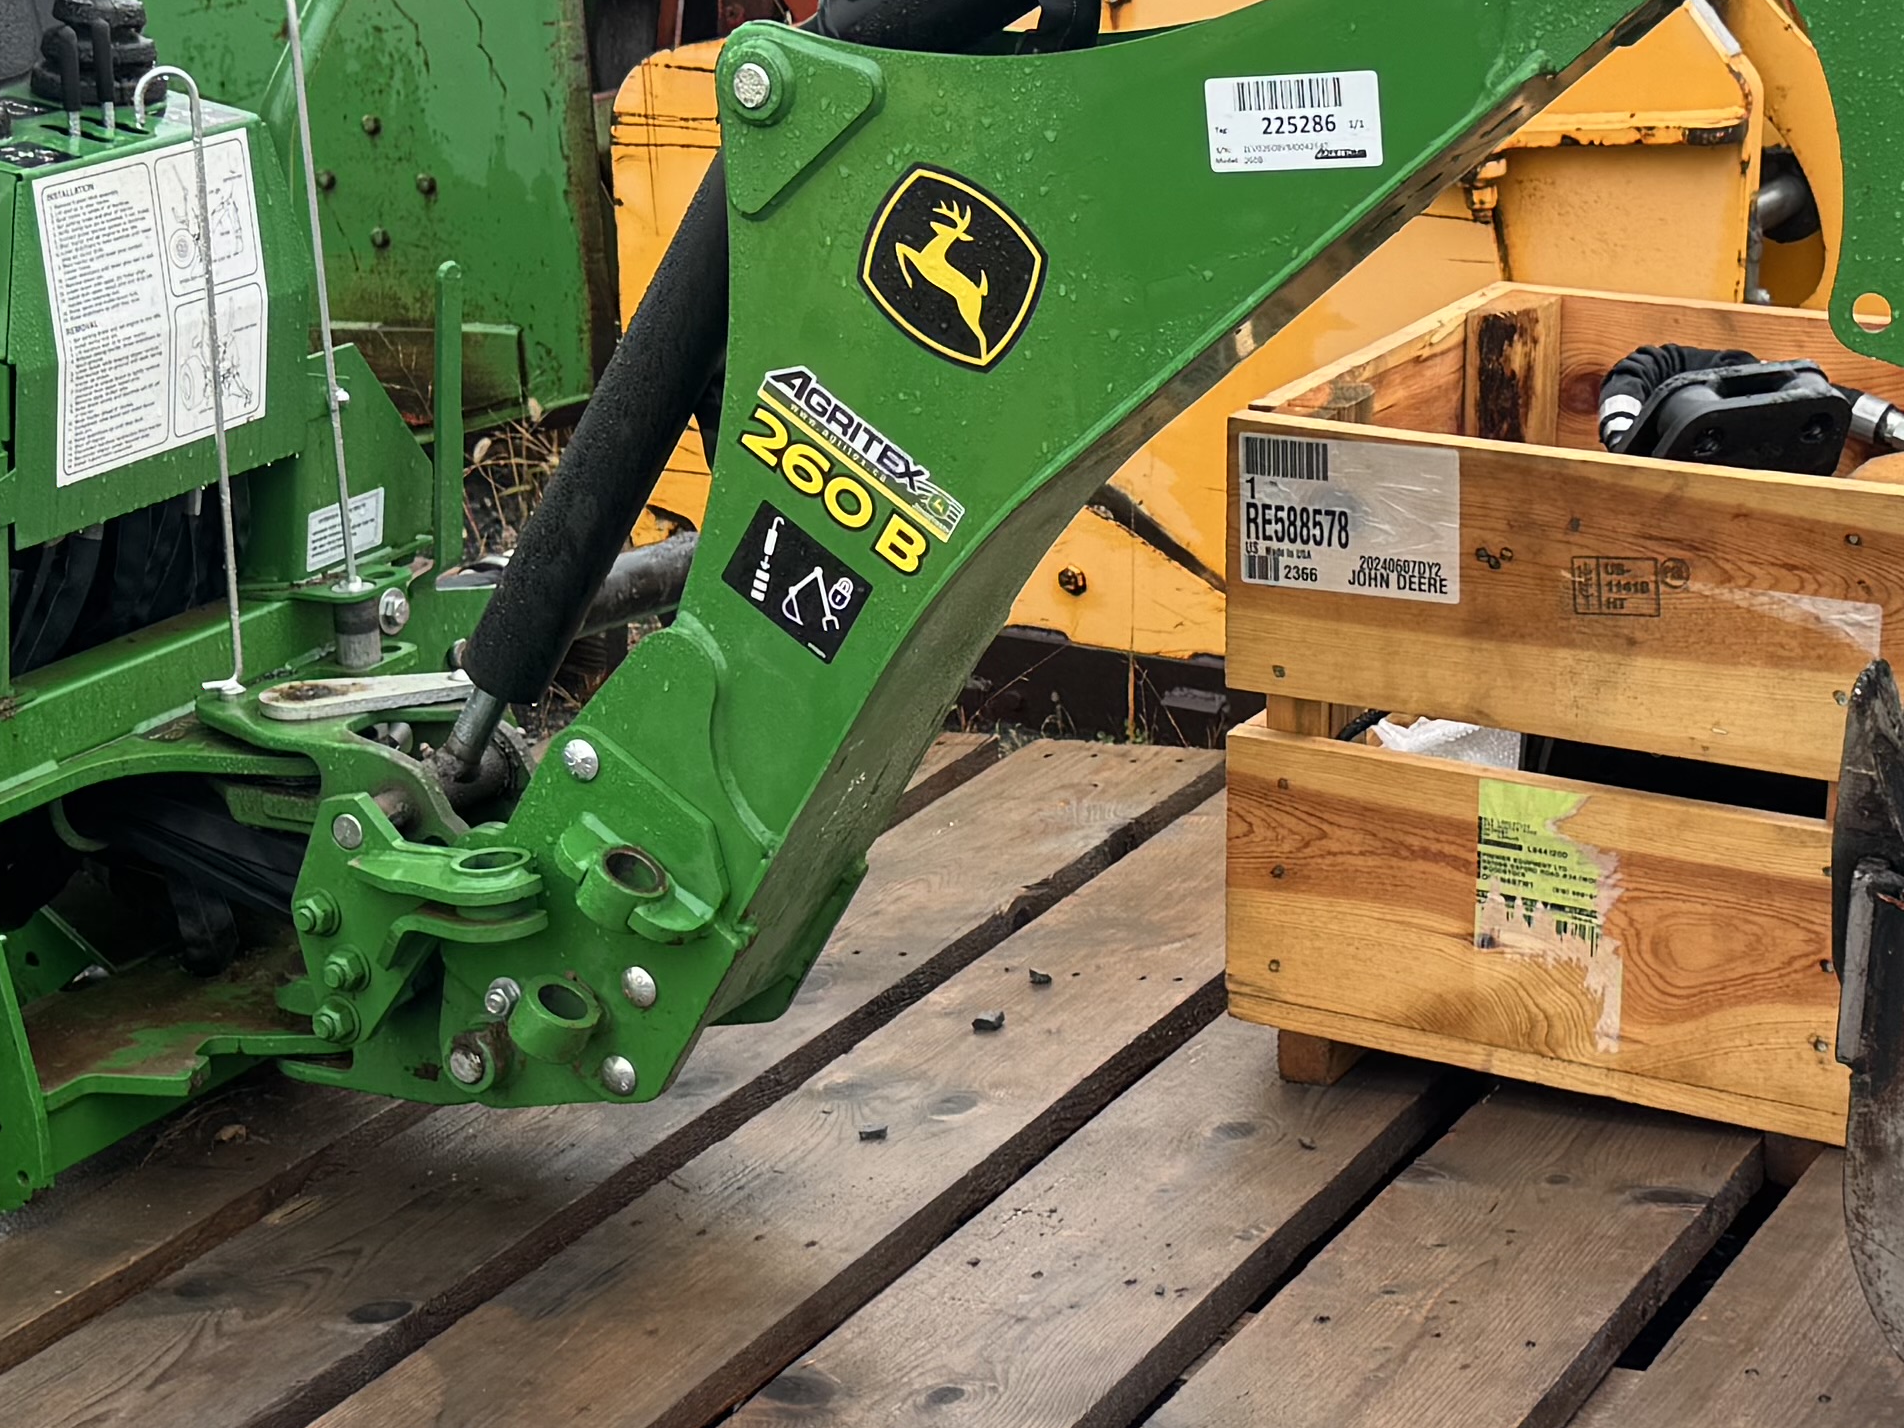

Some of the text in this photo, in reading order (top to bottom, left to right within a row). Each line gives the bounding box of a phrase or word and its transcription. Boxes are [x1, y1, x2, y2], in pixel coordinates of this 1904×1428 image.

[1262, 114, 1365, 134] 225286 1/1
[769, 370, 924, 492] AGRITEX
[741, 407, 927, 573] 260 B
[1246, 476, 1256, 499] 1
[1246, 502, 1349, 549] RE588578
[1246, 541, 1259, 554] US
[1348, 570, 1448, 595] JOHN DEERE
